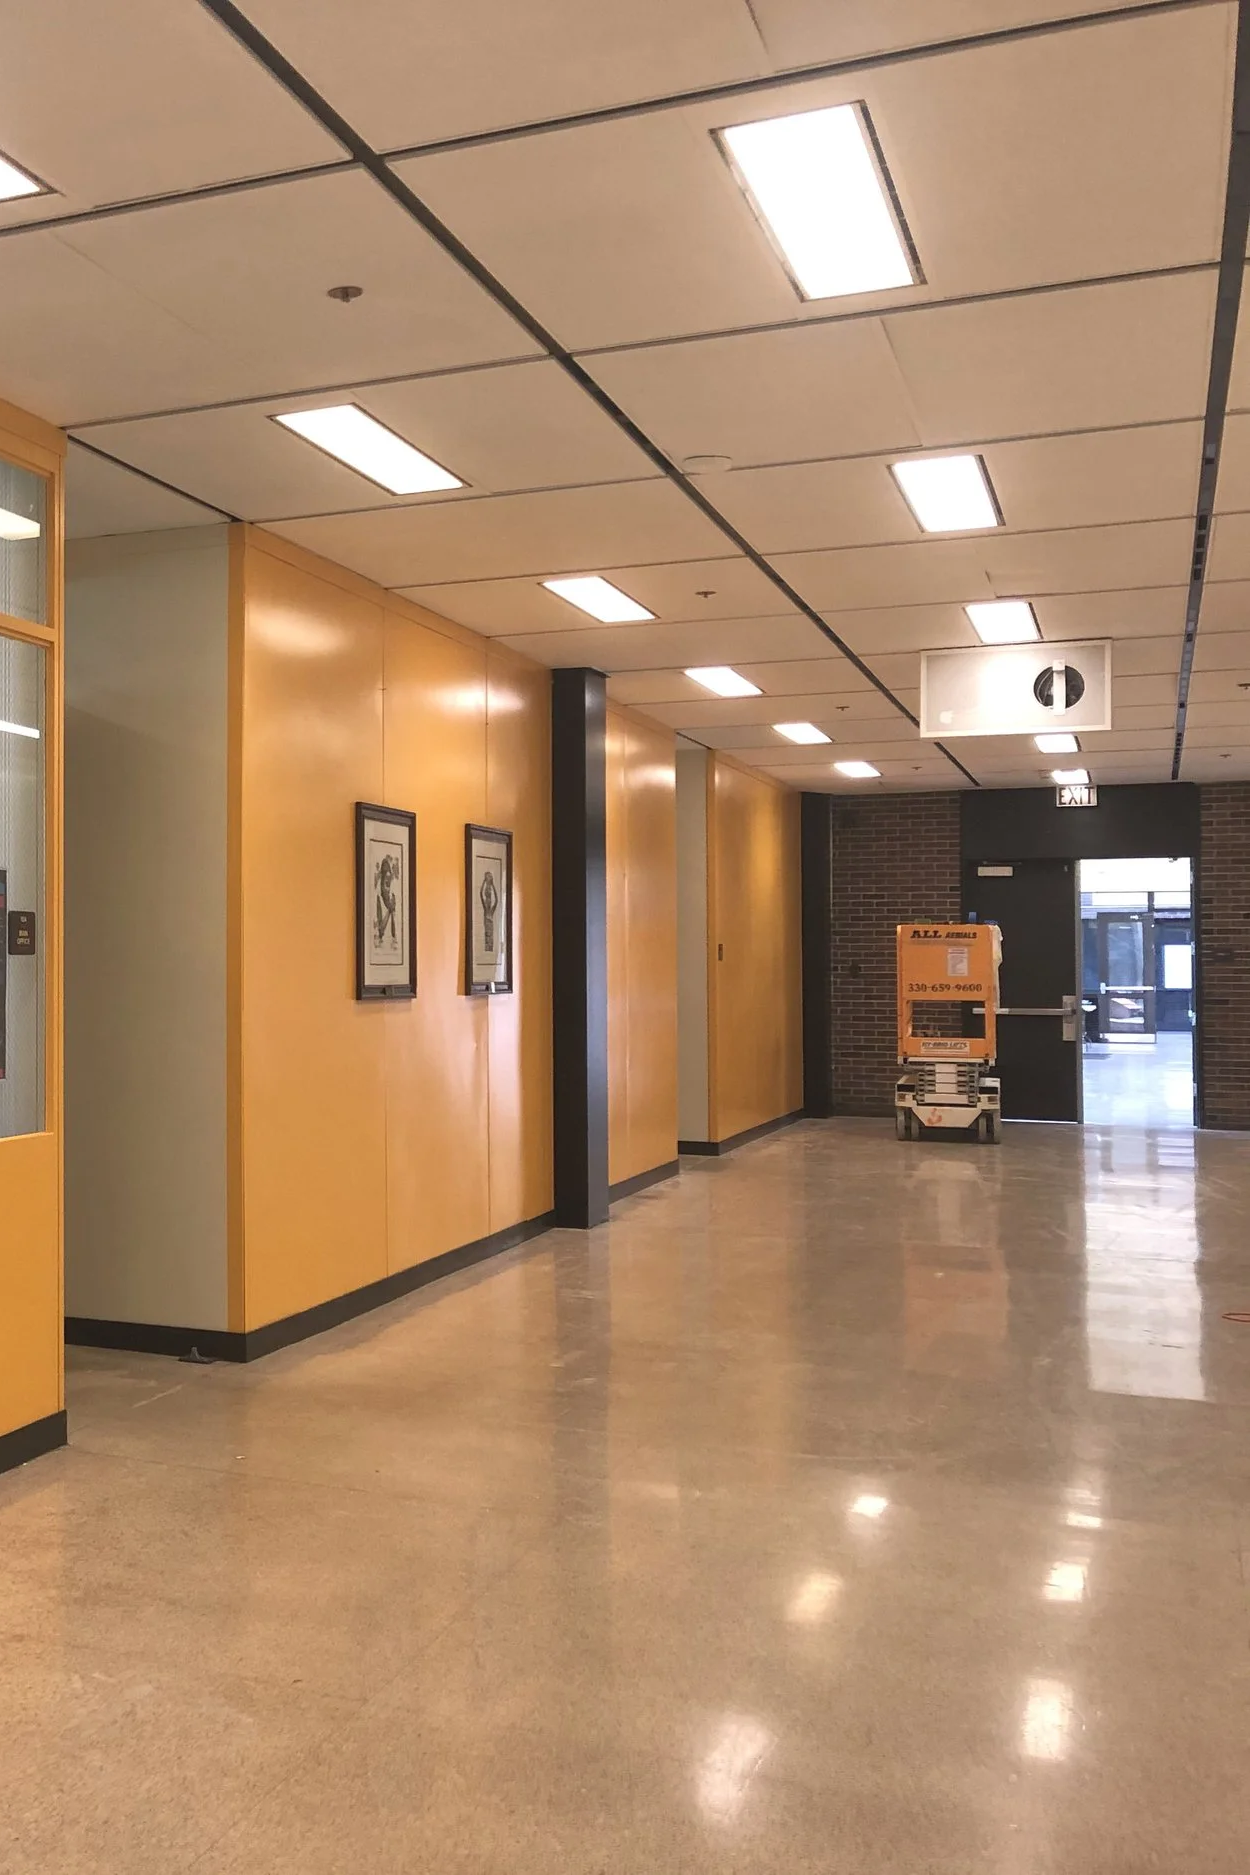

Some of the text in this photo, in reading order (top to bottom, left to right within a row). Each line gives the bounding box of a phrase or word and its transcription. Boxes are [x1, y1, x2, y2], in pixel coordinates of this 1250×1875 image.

[1058, 786, 1095, 805] EXIT
[910, 930, 977, 939] ALL AERIALS
[908, 983, 983, 993] 330-659-9600
